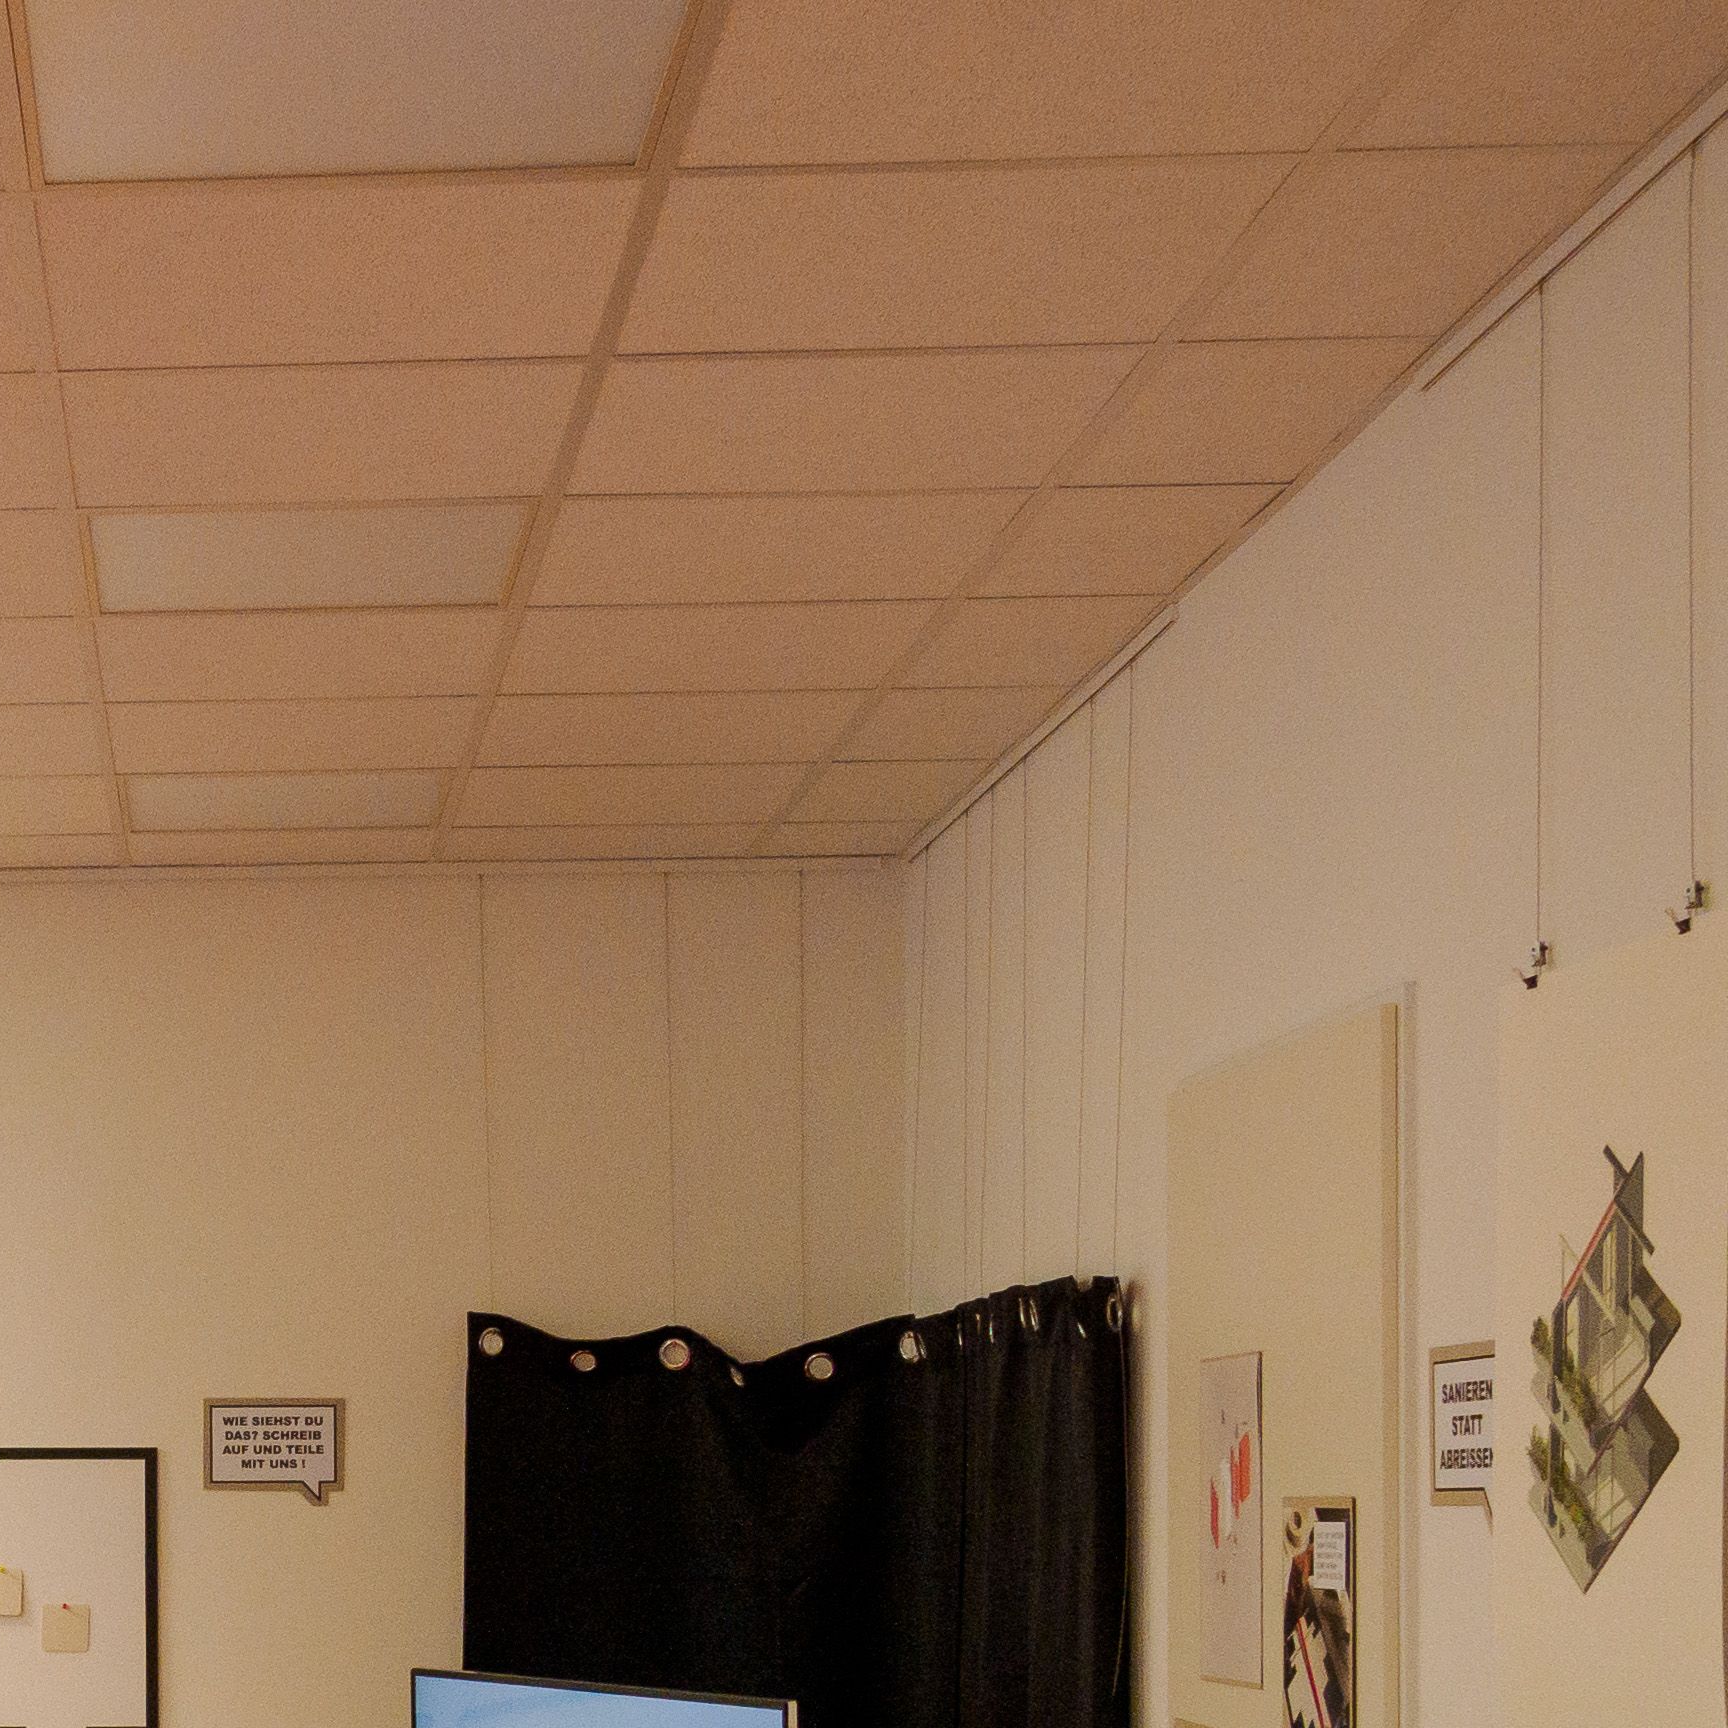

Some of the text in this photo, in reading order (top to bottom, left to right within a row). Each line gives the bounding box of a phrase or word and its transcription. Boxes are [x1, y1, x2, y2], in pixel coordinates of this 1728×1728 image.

[1441, 1379, 1493, 1404] SANIEREN
[222, 1416, 324, 1427] WIE SIEHST DU
[1451, 1414, 1483, 1436] STATT
[224, 1430, 322, 1441] DAS? SCHREIB
[222, 1445, 325, 1455] AUF UND TEILE
[241, 1459, 265, 1469] MIT
[269, 1459, 298, 1469] UNS
